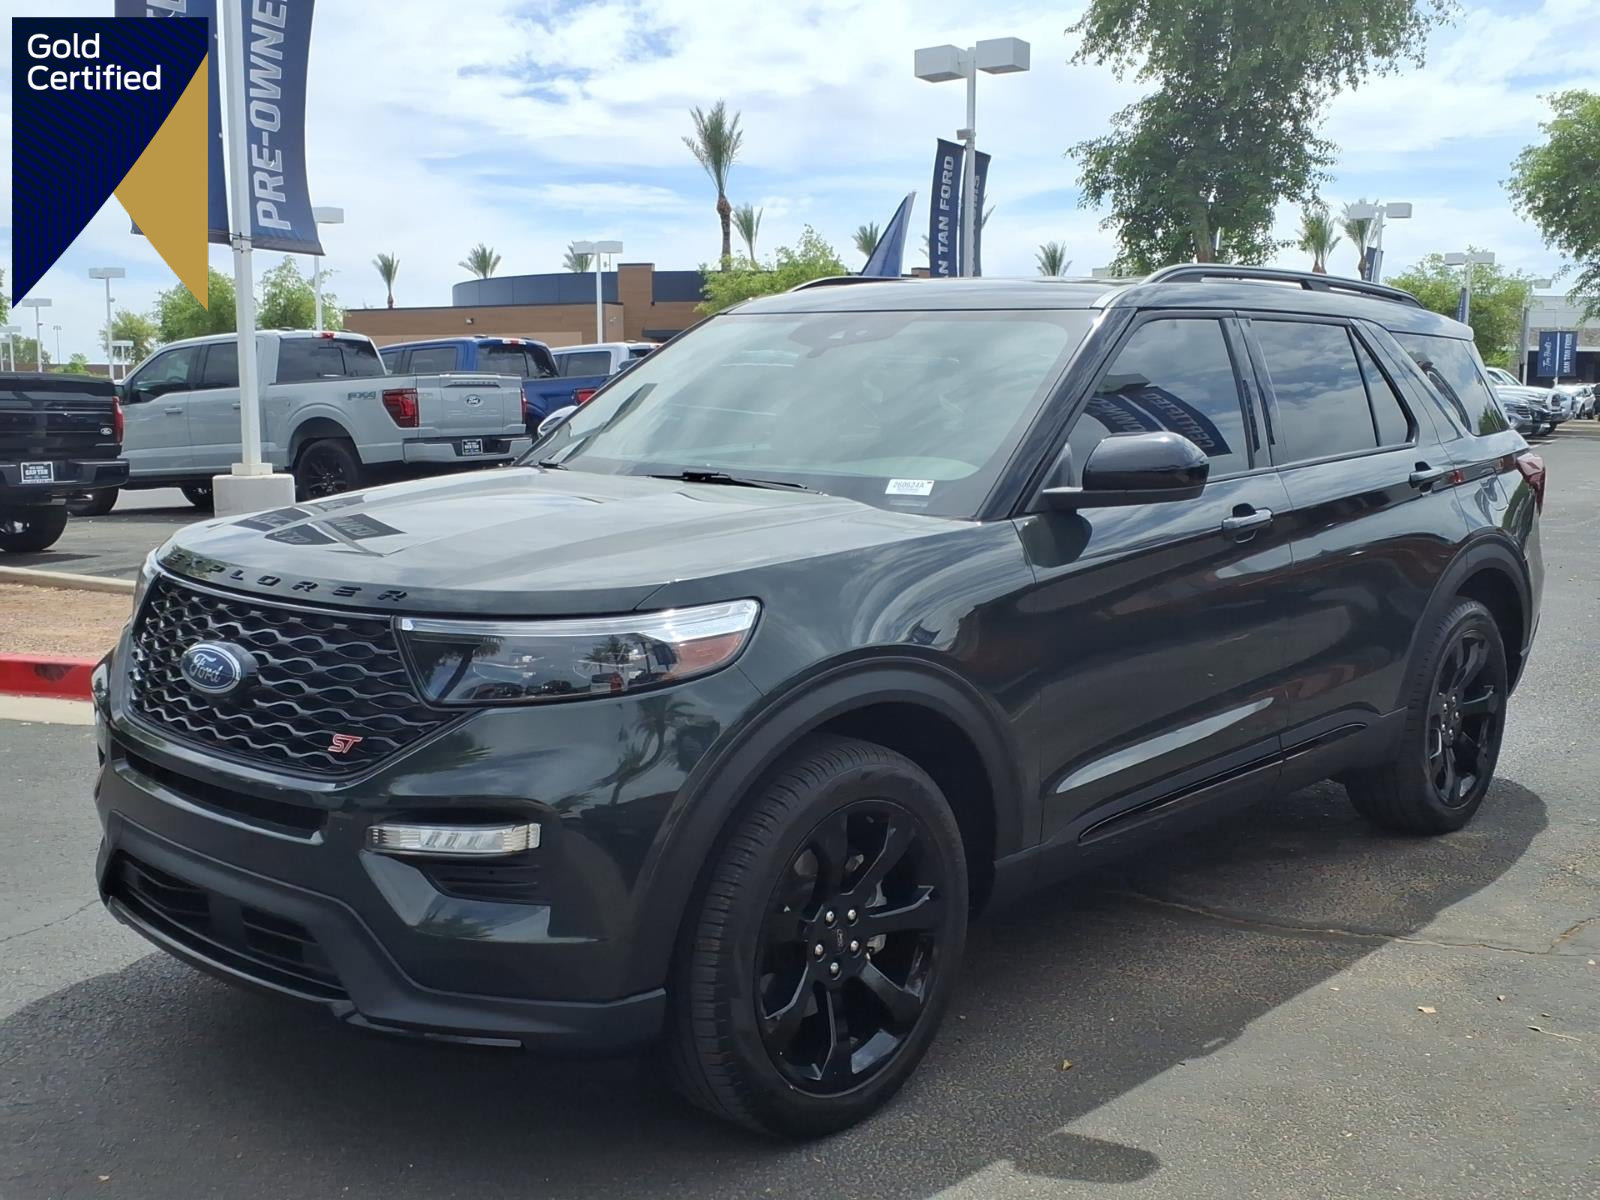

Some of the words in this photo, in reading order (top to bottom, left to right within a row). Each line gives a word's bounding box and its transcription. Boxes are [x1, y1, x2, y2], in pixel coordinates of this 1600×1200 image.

[249, 0, 291, 230] PRE-OWNE
[939, 155, 954, 211] FORD
[938, 216, 949, 256] TAN
[169, 553, 408, 601] EXPLORER
[190, 655, 224, 683] Ford
[328, 733, 363, 753] ST
